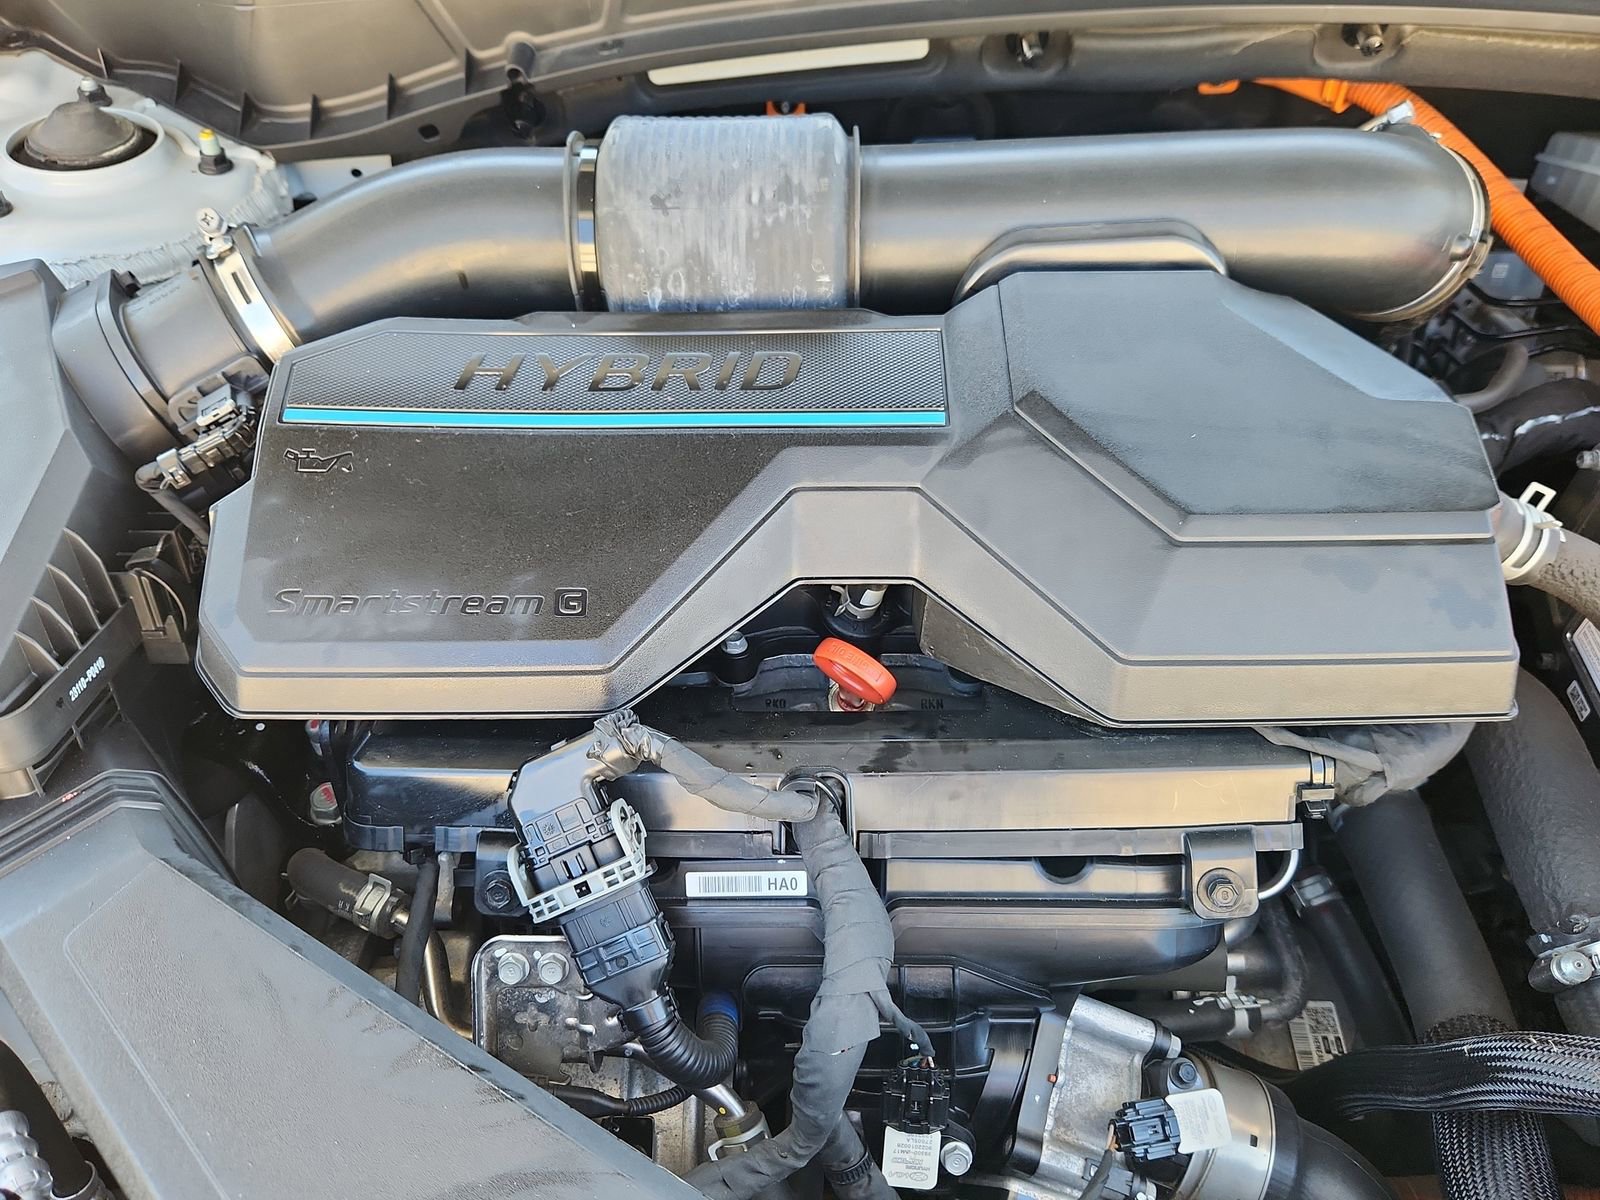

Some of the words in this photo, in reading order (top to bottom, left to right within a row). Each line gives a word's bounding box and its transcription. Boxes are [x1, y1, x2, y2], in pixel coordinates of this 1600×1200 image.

[453, 351, 803, 392] HYBRID
[267, 588, 545, 616] Smartstream
[557, 590, 585, 615] G
[920, 698, 944, 710] RKN
